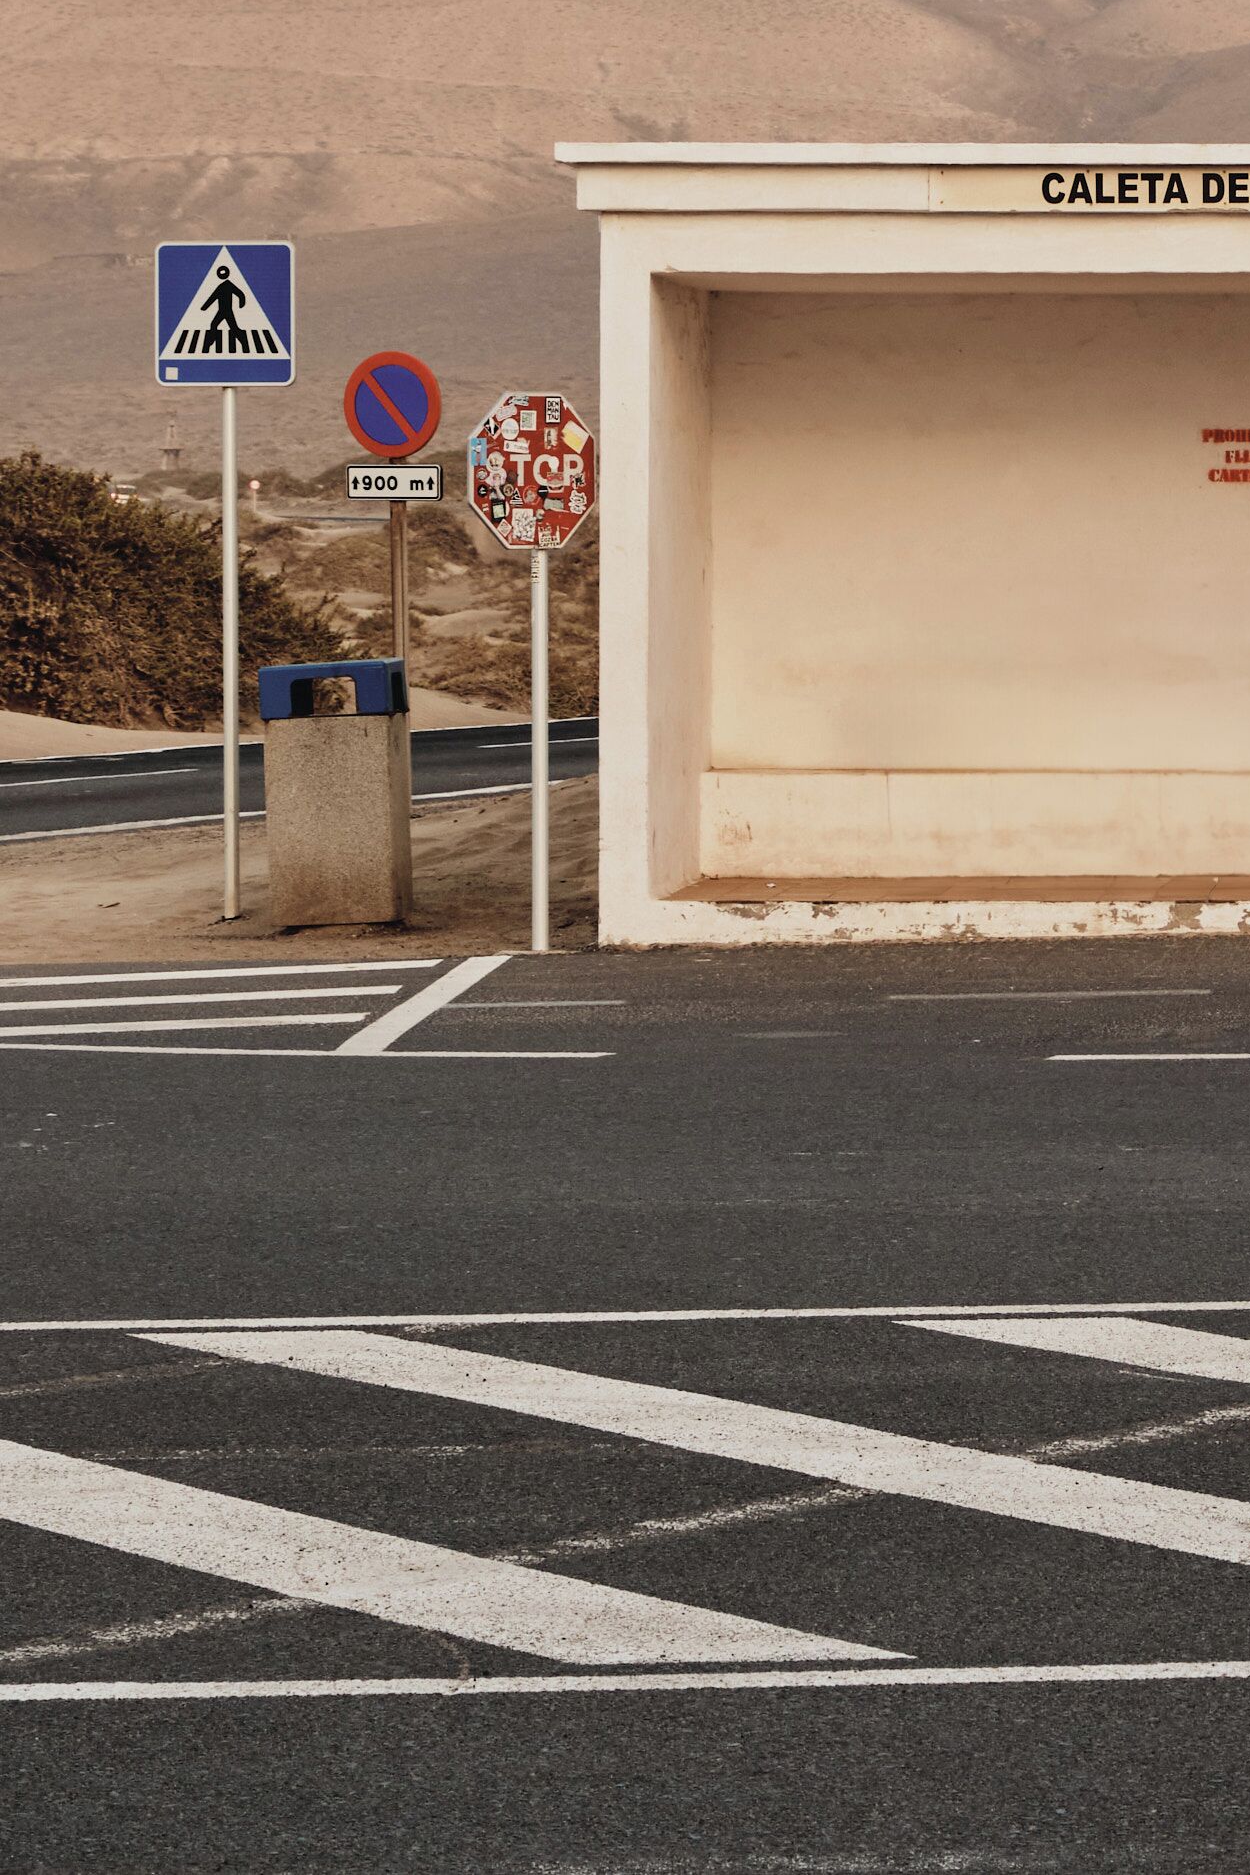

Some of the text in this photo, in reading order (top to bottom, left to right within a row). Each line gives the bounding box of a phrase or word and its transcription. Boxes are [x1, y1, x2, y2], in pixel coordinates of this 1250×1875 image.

[1042, 172, 1188, 204] CALETA
[1202, 173, 1249, 203] DE
[362, 475, 424, 490] 900 m
[487, 453, 584, 486] TOP
